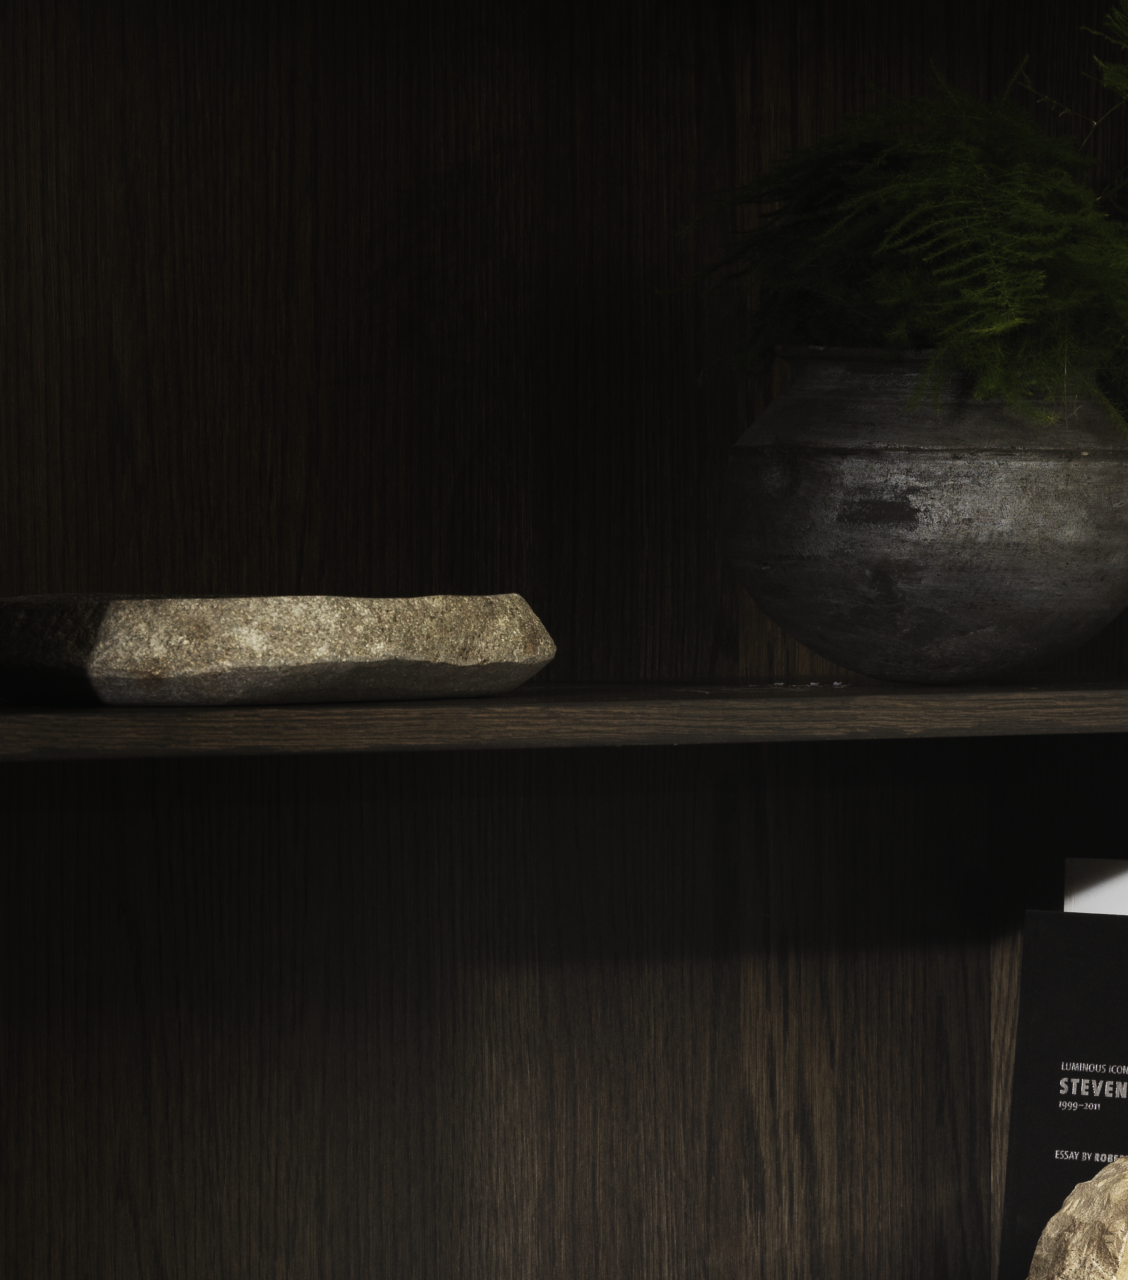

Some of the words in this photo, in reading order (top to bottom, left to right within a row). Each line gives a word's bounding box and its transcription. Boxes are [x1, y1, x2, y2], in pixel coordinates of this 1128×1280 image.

[1061, 1061, 1106, 1074] LUMINOUS
[1059, 1077, 1128, 1099] STEVEN
[1054, 1149, 1080, 1160] ESSAY
[1081, 1151, 1093, 1162] BY
